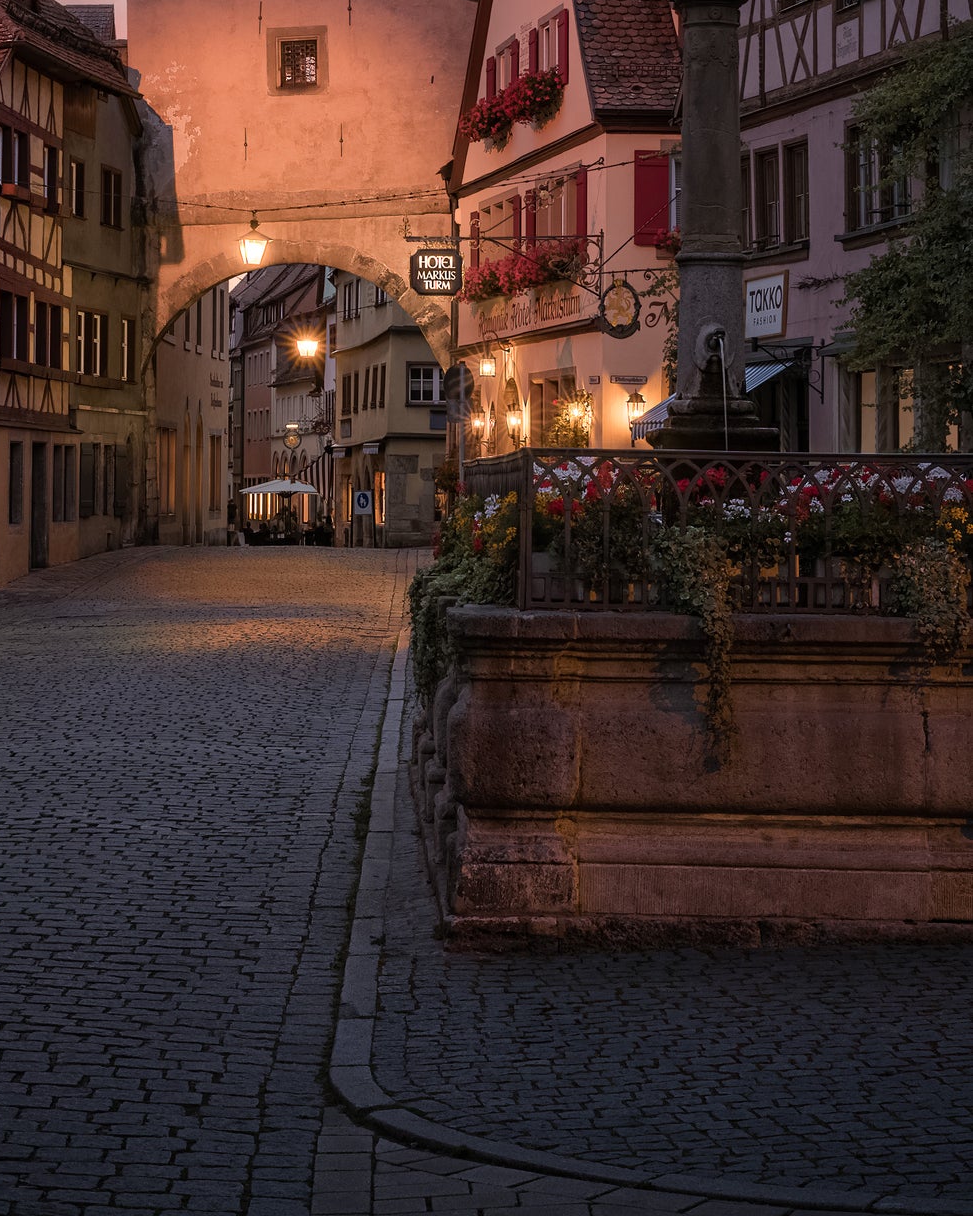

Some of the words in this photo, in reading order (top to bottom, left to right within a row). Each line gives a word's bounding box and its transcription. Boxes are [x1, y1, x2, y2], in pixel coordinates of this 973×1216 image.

[418, 255, 456, 269] HOTEL
[417, 270, 457, 280] MARKUS
[423, 280, 451, 290] TURM
[511, 300, 531, 330] Hotel
[534, 293, 580, 325] Markusturm
[753, 315, 777, 326] FASHION
